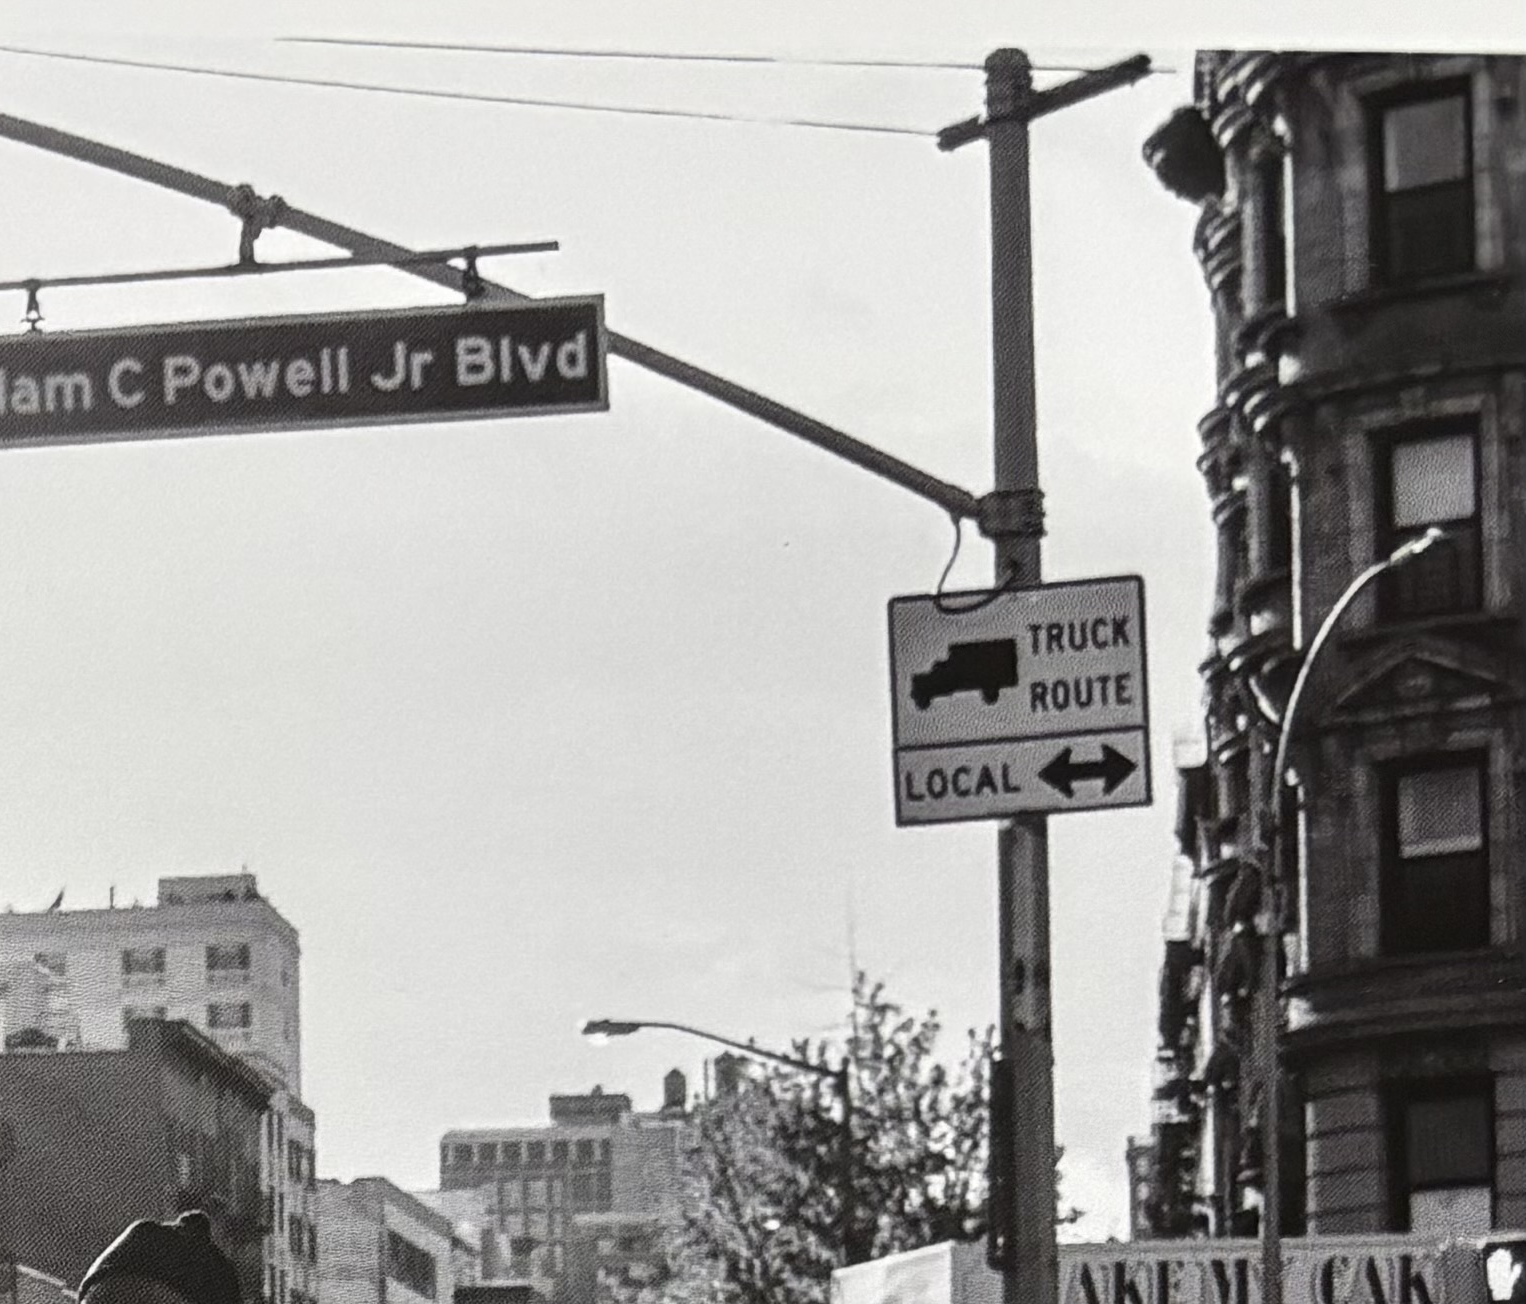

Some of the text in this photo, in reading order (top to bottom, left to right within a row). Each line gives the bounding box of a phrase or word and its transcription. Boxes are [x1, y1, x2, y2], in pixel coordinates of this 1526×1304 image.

[109, 361, 145, 408] C
[164, 348, 350, 406] Powell
[371, 345, 433, 391] Jr
[456, 330, 589, 387] Blvd
[1028, 615, 1130, 656] TRUCK
[1030, 672, 1132, 712] ROUTE
[905, 763, 1021, 802] LOCAL
